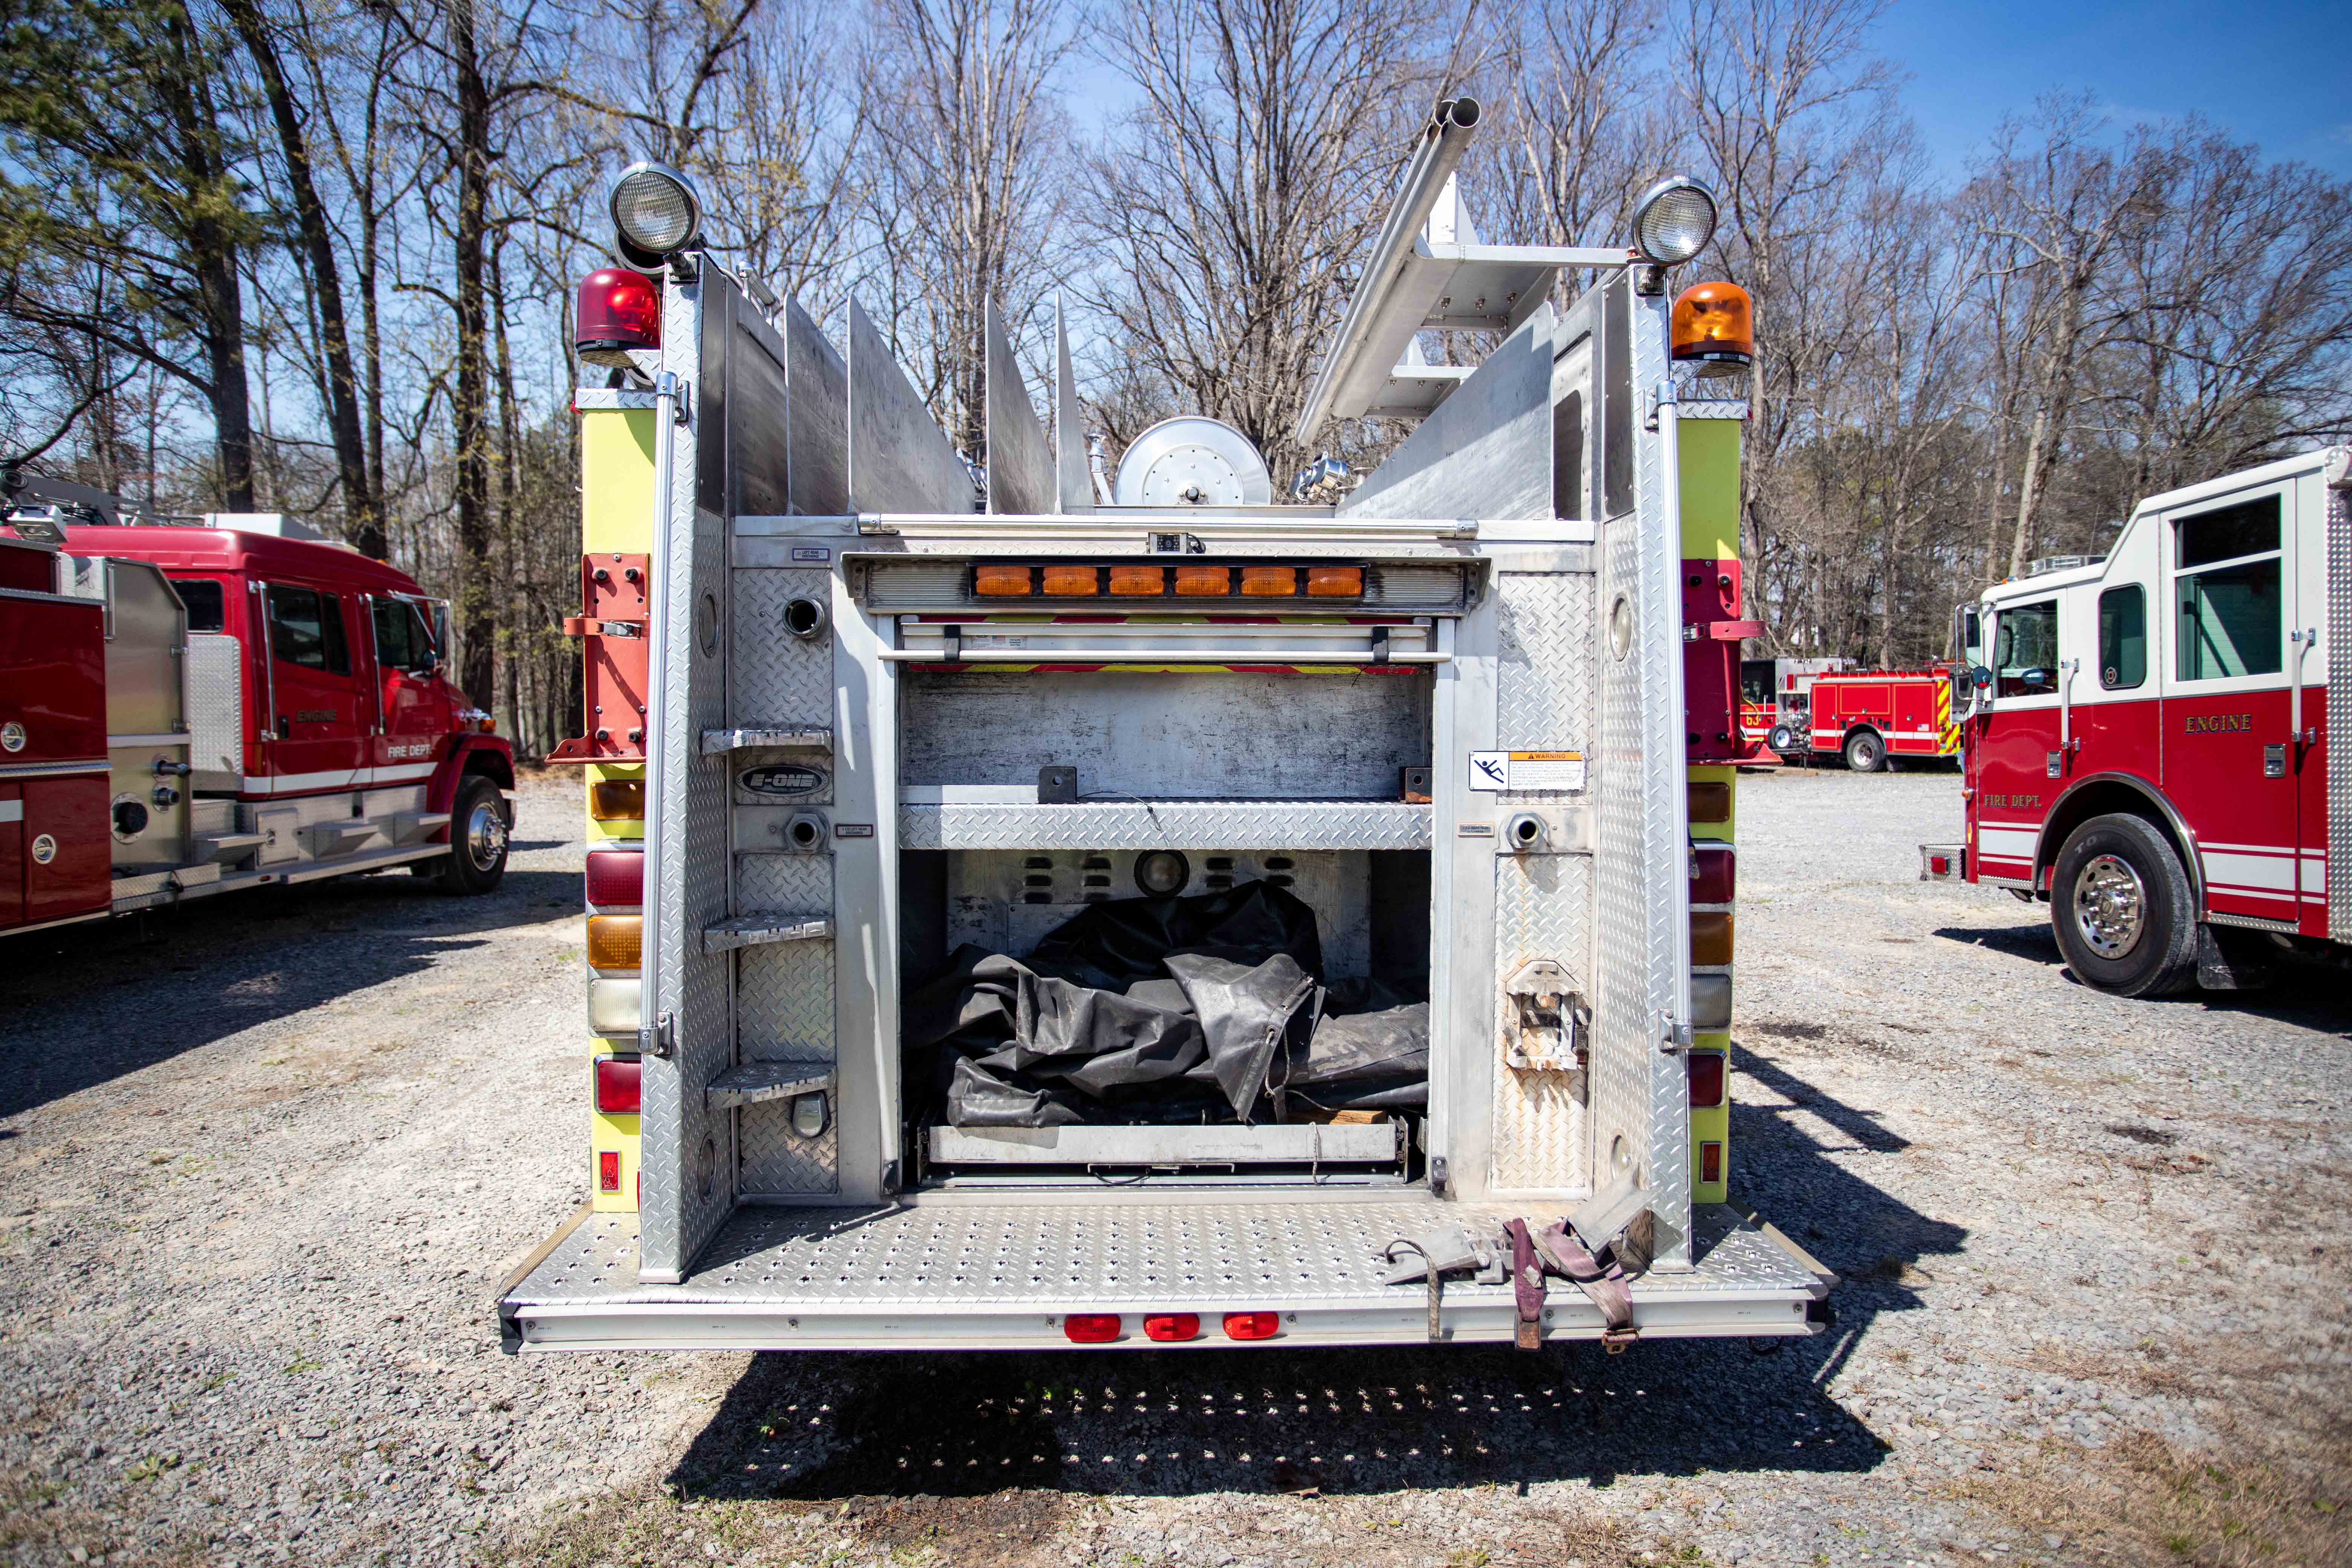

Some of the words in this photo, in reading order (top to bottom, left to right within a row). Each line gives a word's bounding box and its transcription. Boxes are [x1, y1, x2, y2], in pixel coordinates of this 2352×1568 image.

[296, 709, 337, 723] ENGINE
[1746, 715, 1759, 726] 63
[2184, 714, 2251, 734] ENGINE
[387, 745, 407, 758] FIRE
[750, 774, 815, 787] E-ONE
[1984, 795, 2007, 808] FIRE
[2011, 795, 2042, 808] DEPT.
